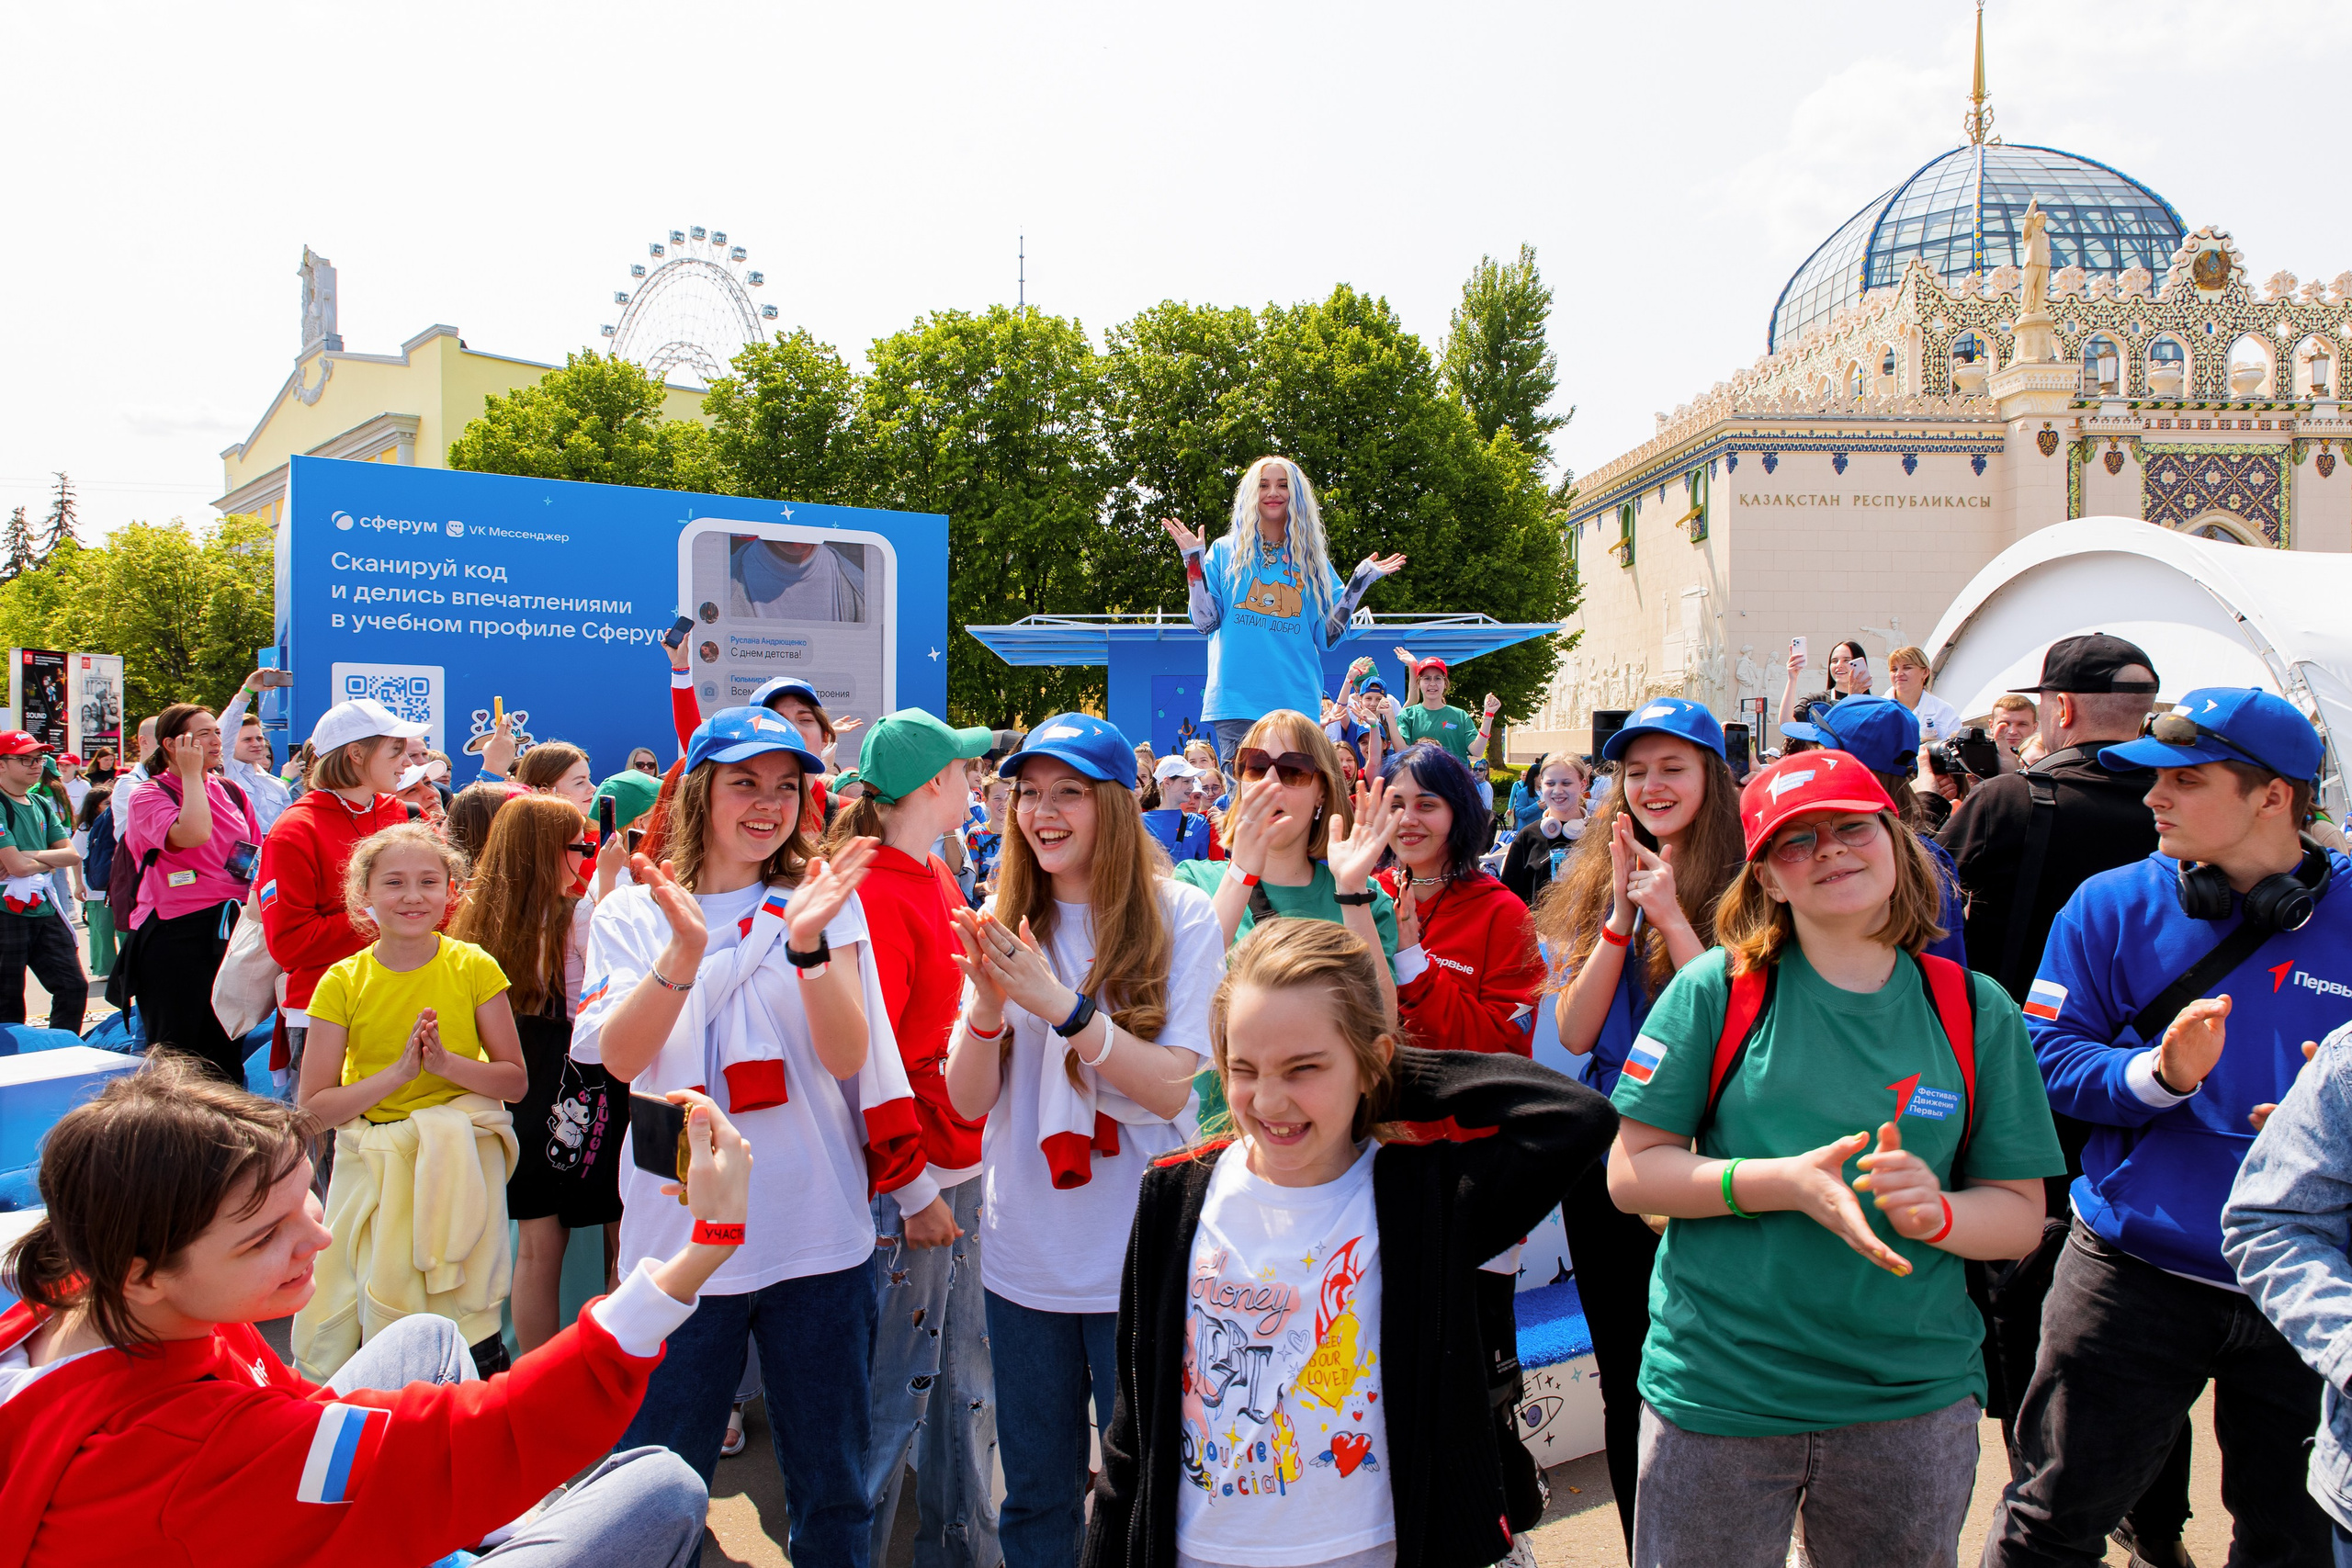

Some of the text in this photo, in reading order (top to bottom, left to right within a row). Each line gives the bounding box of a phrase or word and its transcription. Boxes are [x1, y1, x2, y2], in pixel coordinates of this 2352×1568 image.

[1853, 494, 1991, 508] РЕСПУБЛИКАСЫ
[359, 514, 438, 535] сферум
[469, 525, 570, 544] VK Мессенджер
[331, 551, 508, 583] Сканируй код
[332, 584, 632, 615] и делись впечатлениями
[332, 613, 345, 628] в
[351, 613, 462, 634] учебном
[469, 618, 576, 640] профиле
[1233, 613, 1301, 635] ЗАТАИЛ ДОБРО
[730, 636, 808, 647] Руслана Андрющенко
[730, 647, 802, 660] С днем детства!
[730, 675, 766, 684] Гюльмира
[815, 690, 850, 699] троения
[1917, 1088, 1958, 1101] Фестиваль
[1913, 1095, 1954, 1109] Движения
[1909, 1104, 1943, 1117] Первых
[1192, 1251, 1291, 1336] Honey
